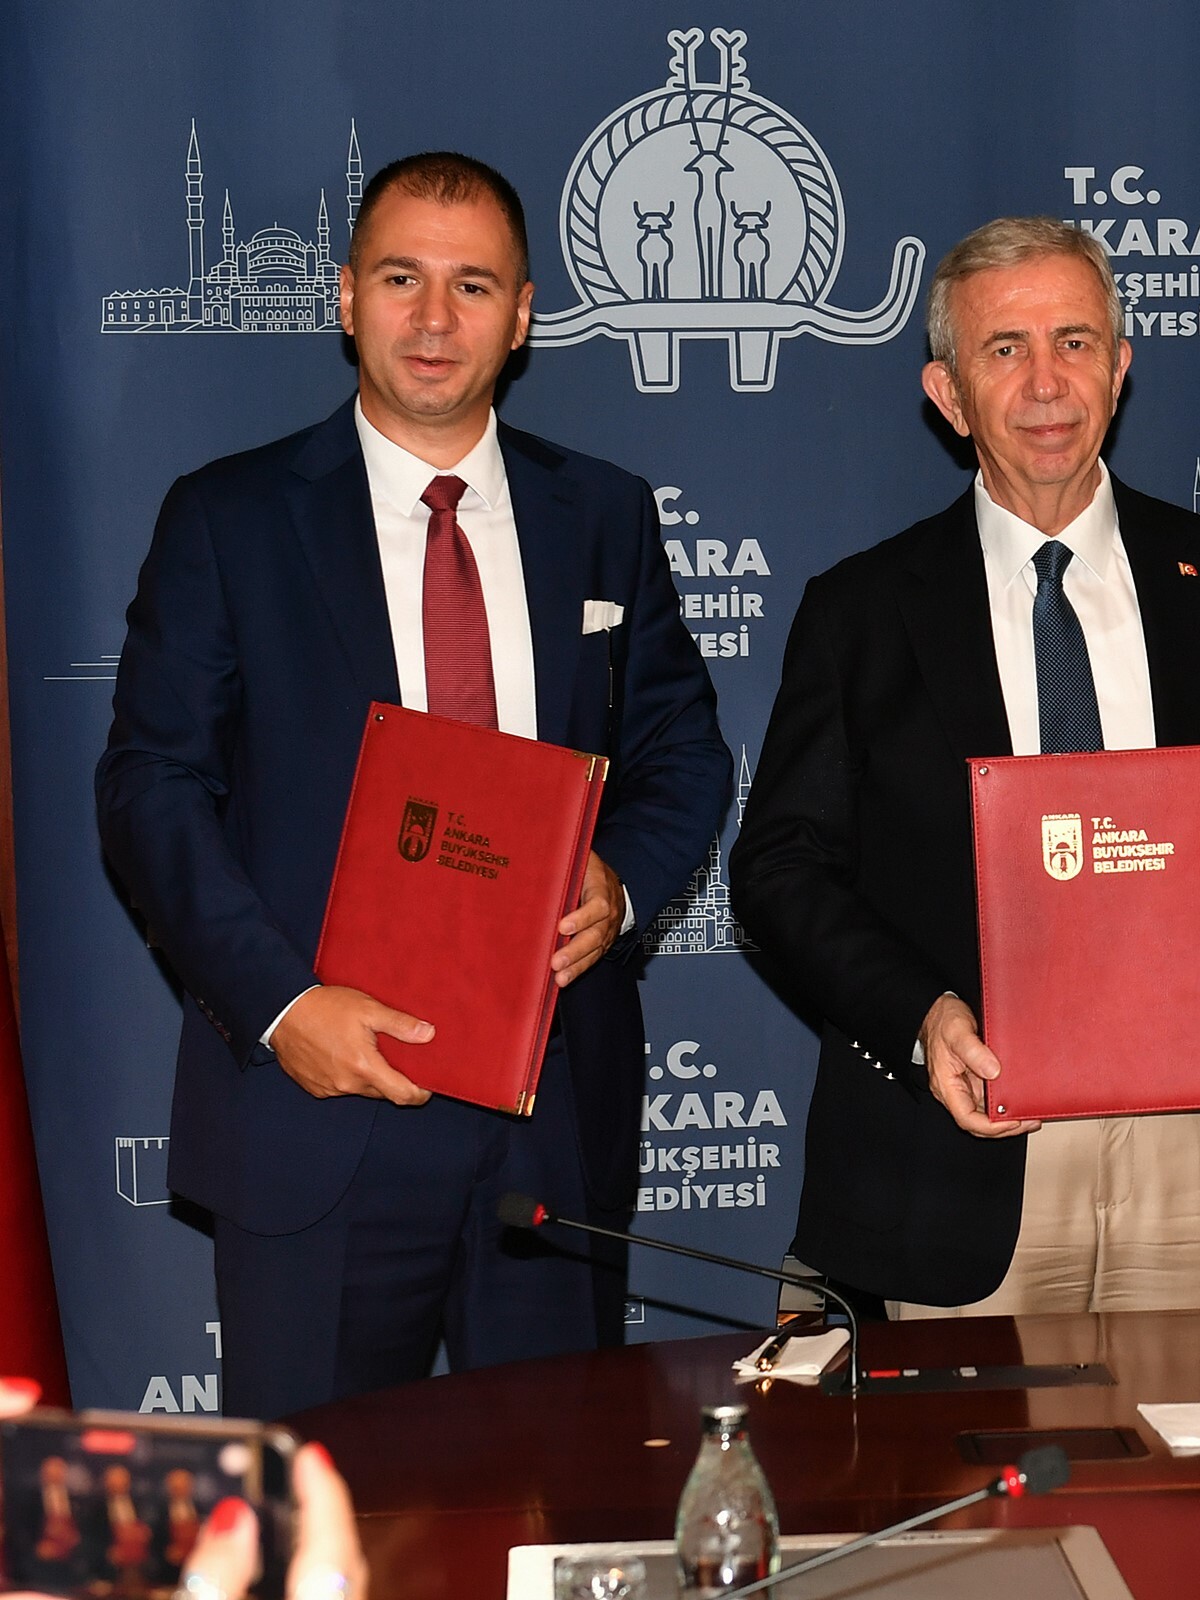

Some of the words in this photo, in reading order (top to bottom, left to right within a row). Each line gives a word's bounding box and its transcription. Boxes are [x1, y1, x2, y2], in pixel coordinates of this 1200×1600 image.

[1064, 165, 1161, 205] T.C.
[653, 486, 700, 526] C.
[664, 538, 772, 577] ARA
[1091, 817, 1117, 830] T.C.
[1092, 829, 1149, 845] ANKARA
[644, 1040, 718, 1080] .C.
[640, 1090, 788, 1132] KARA
[638, 1136, 781, 1178] ÜKŞEHİR
[634, 1174, 766, 1212] EDİYESİ
